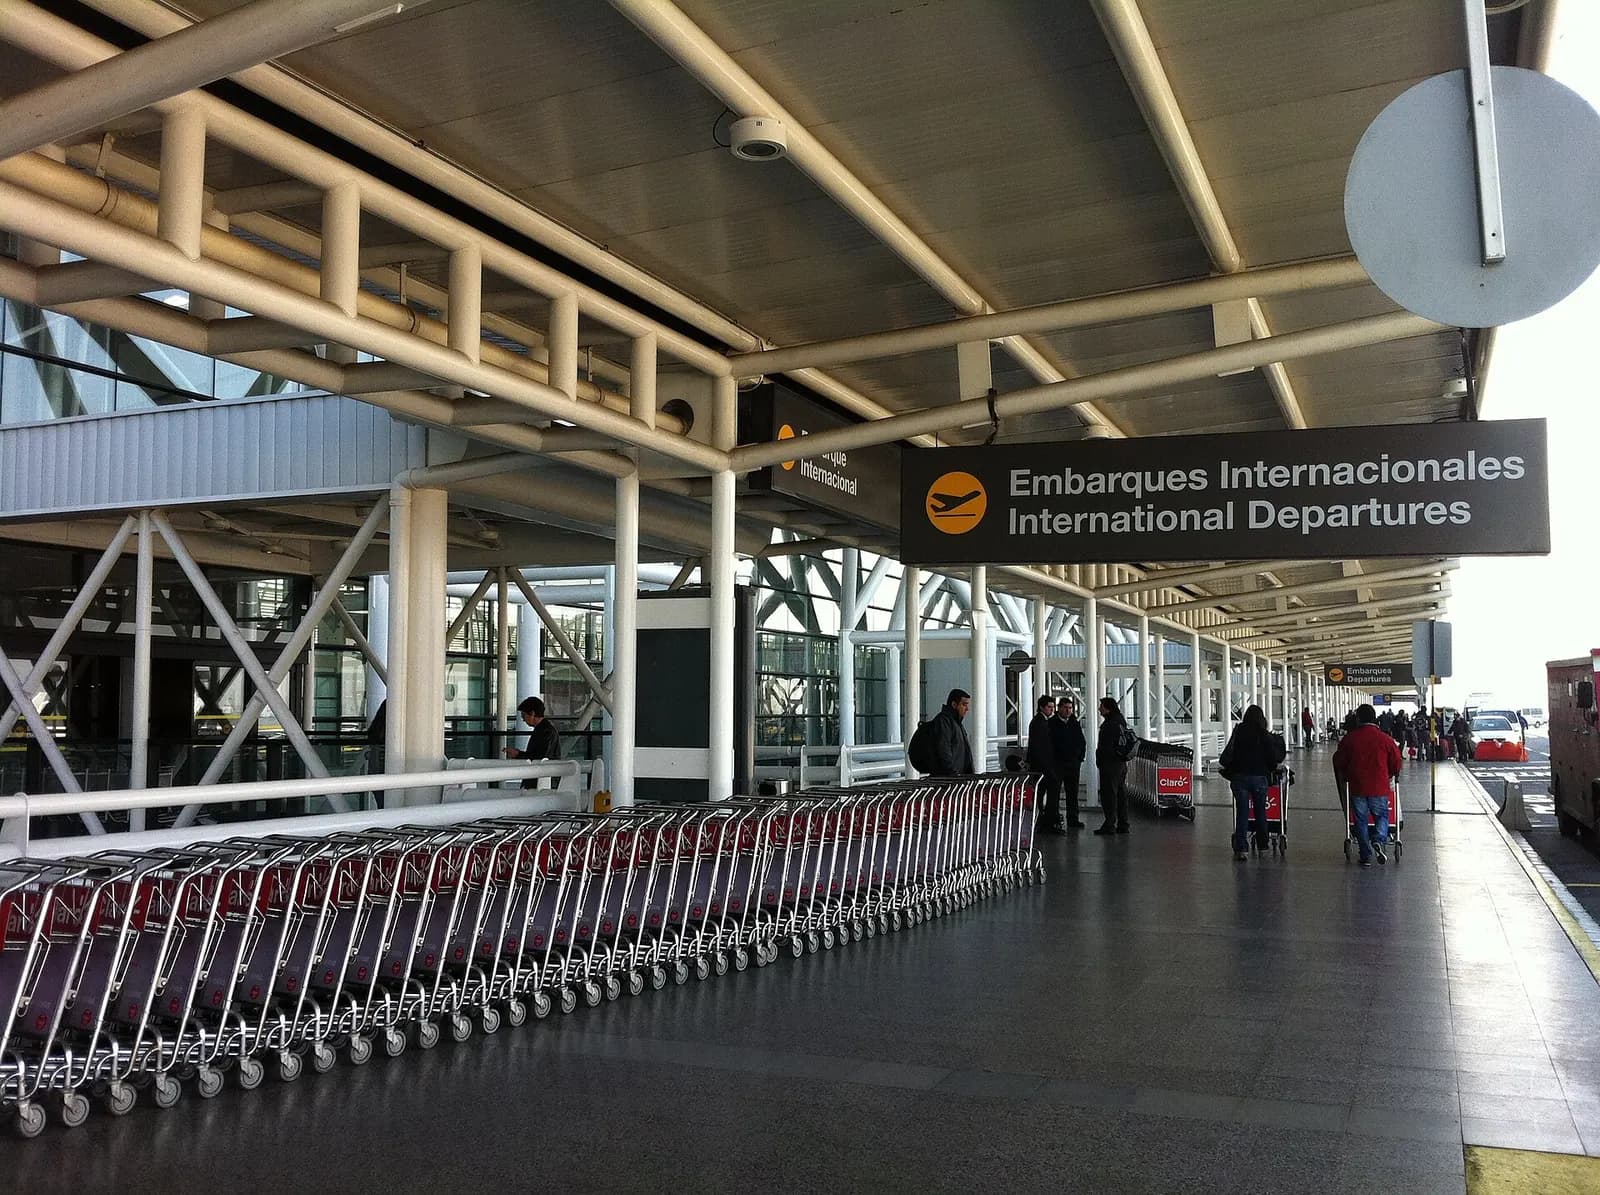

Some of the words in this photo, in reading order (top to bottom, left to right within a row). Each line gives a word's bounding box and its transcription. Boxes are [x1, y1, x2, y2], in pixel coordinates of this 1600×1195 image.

[800, 458, 857, 495] Internacional
[1010, 467, 1208, 498] Embarques
[1220, 450, 1525, 489] Internacionales
[1009, 501, 1234, 534] International
[1249, 498, 1471, 534] Departures
[1346, 667, 1392, 676] Embarques
[1160, 777, 1184, 787] Claro
